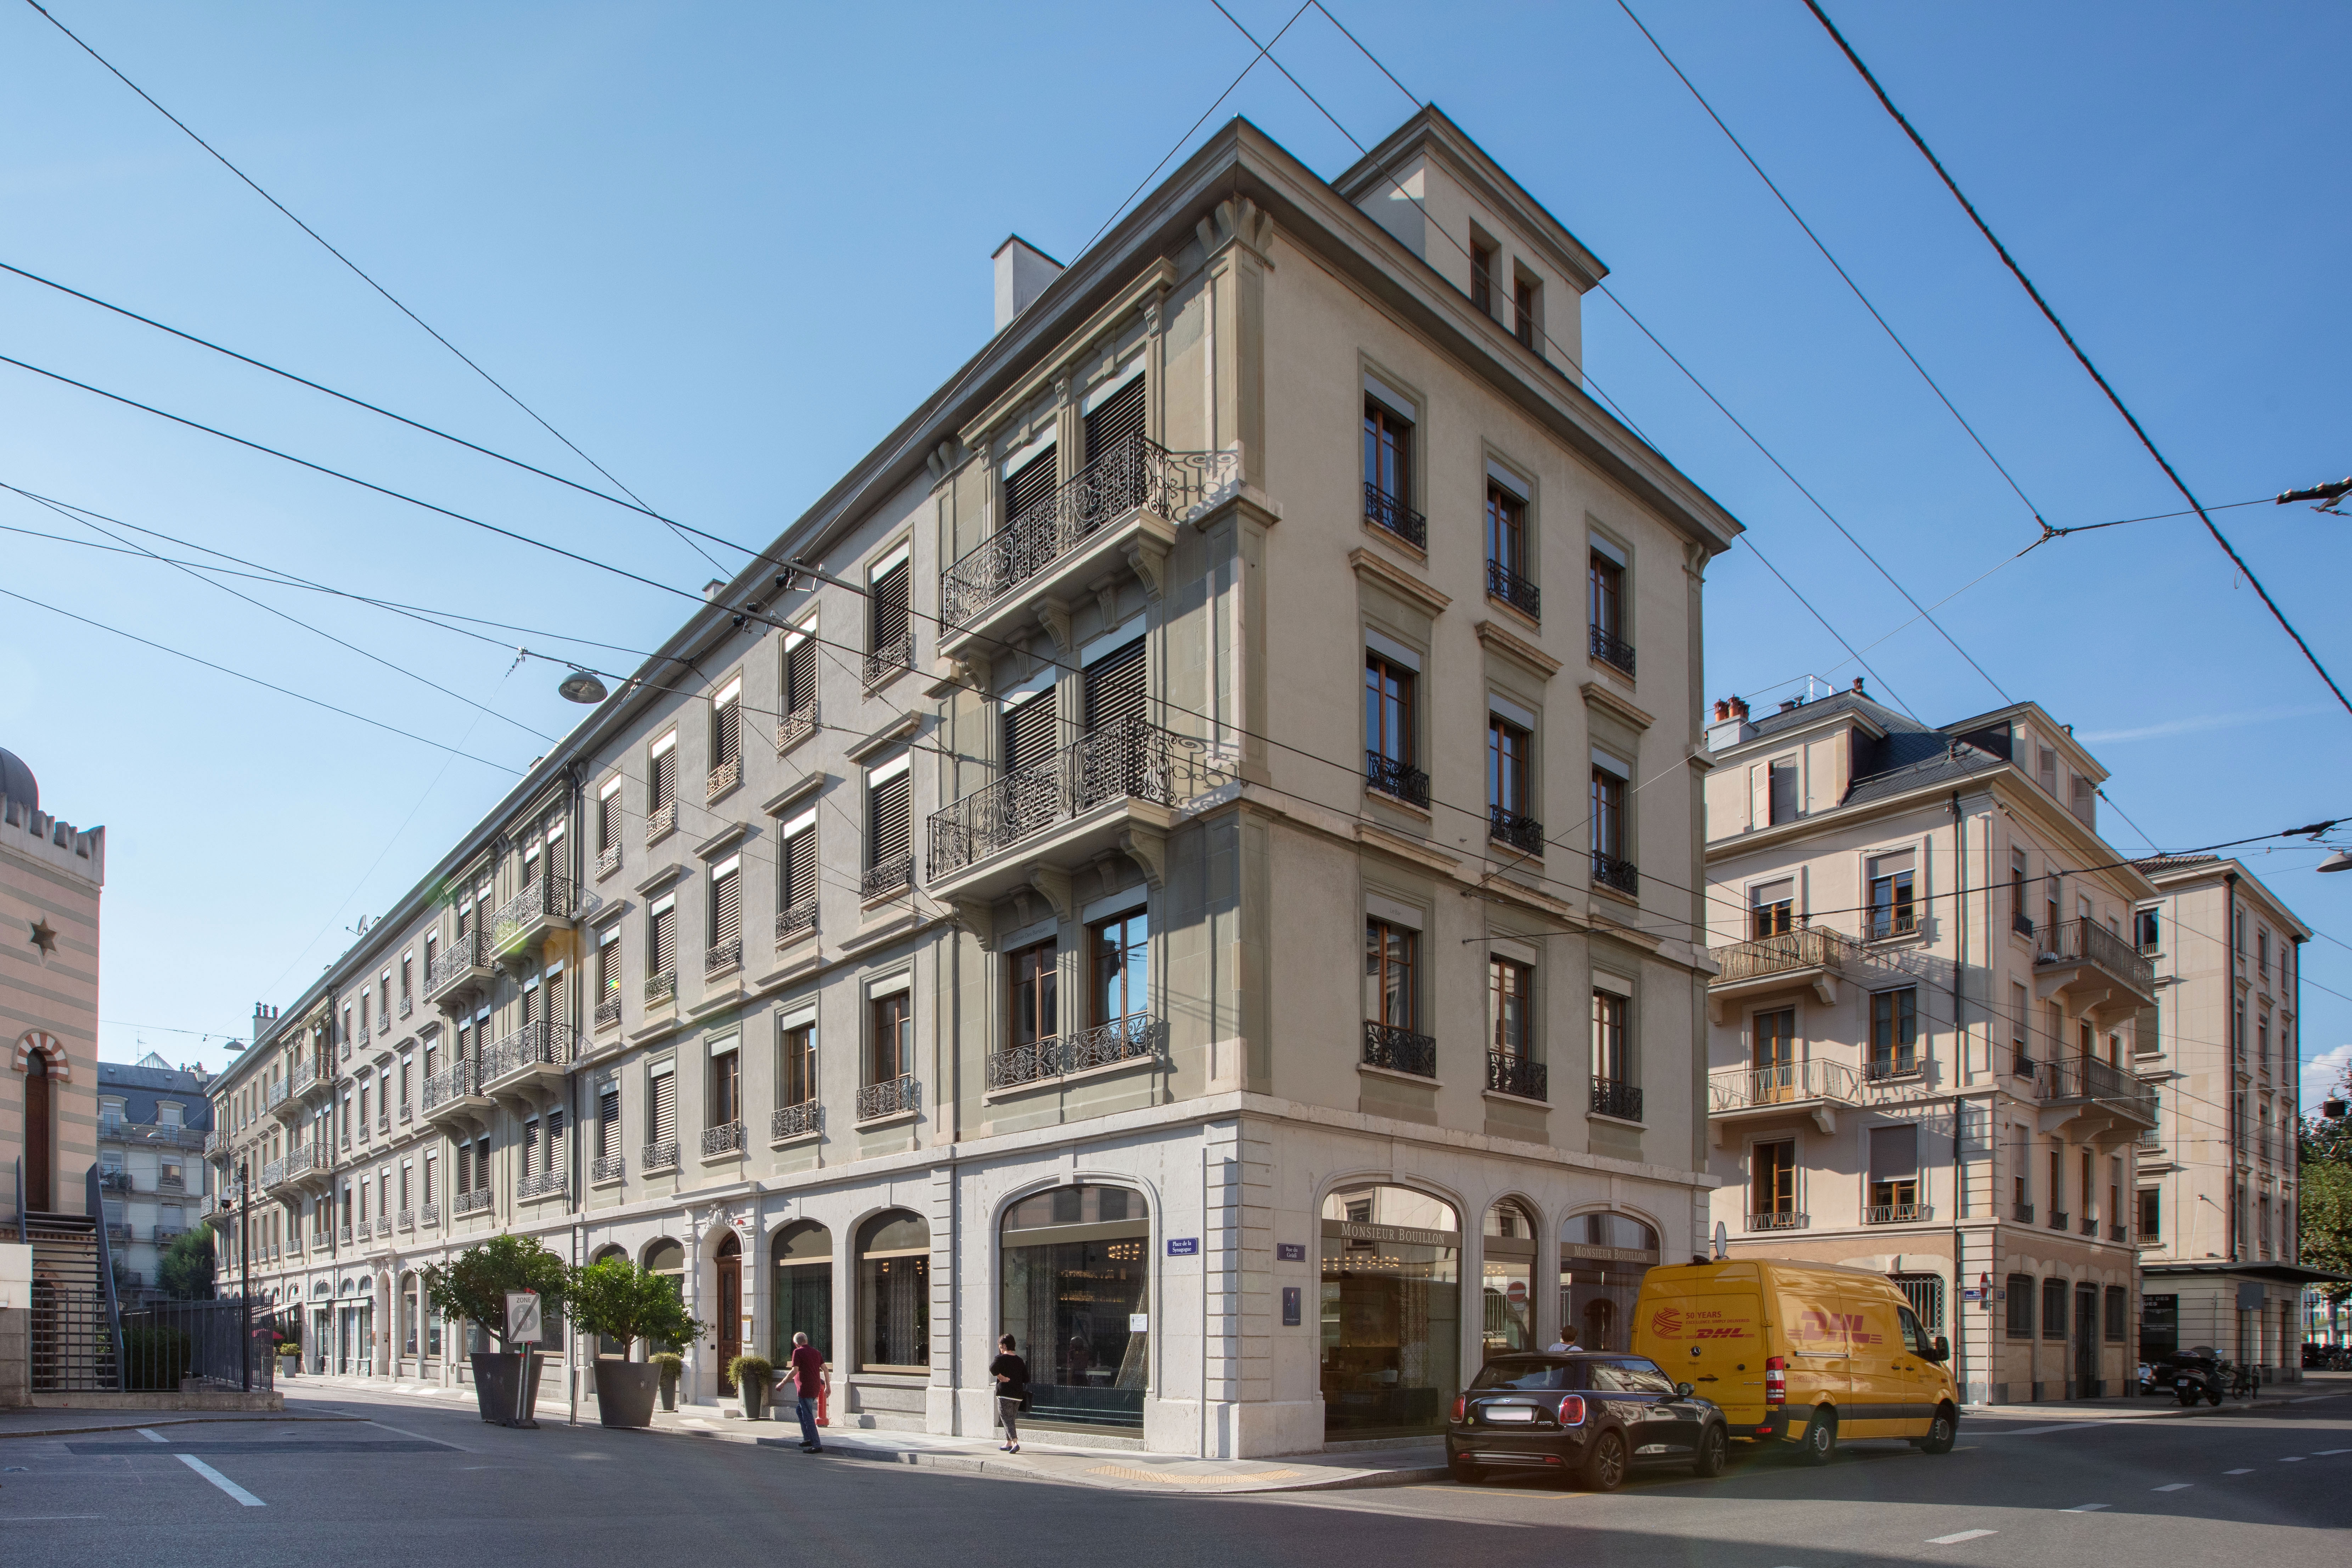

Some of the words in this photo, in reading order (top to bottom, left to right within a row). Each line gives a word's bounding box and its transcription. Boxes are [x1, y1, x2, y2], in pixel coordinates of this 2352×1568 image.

[1341, 1223, 1395, 1240] MONSIEUR
[1399, 1229, 1445, 1244] BOUILLON
[1574, 1246, 1611, 1258] MONSIEUR
[1614, 1249, 1647, 1261] BOUILLON
[1695, 1328, 1745, 1339] DHL
[1801, 1311, 1870, 1343] DHL
